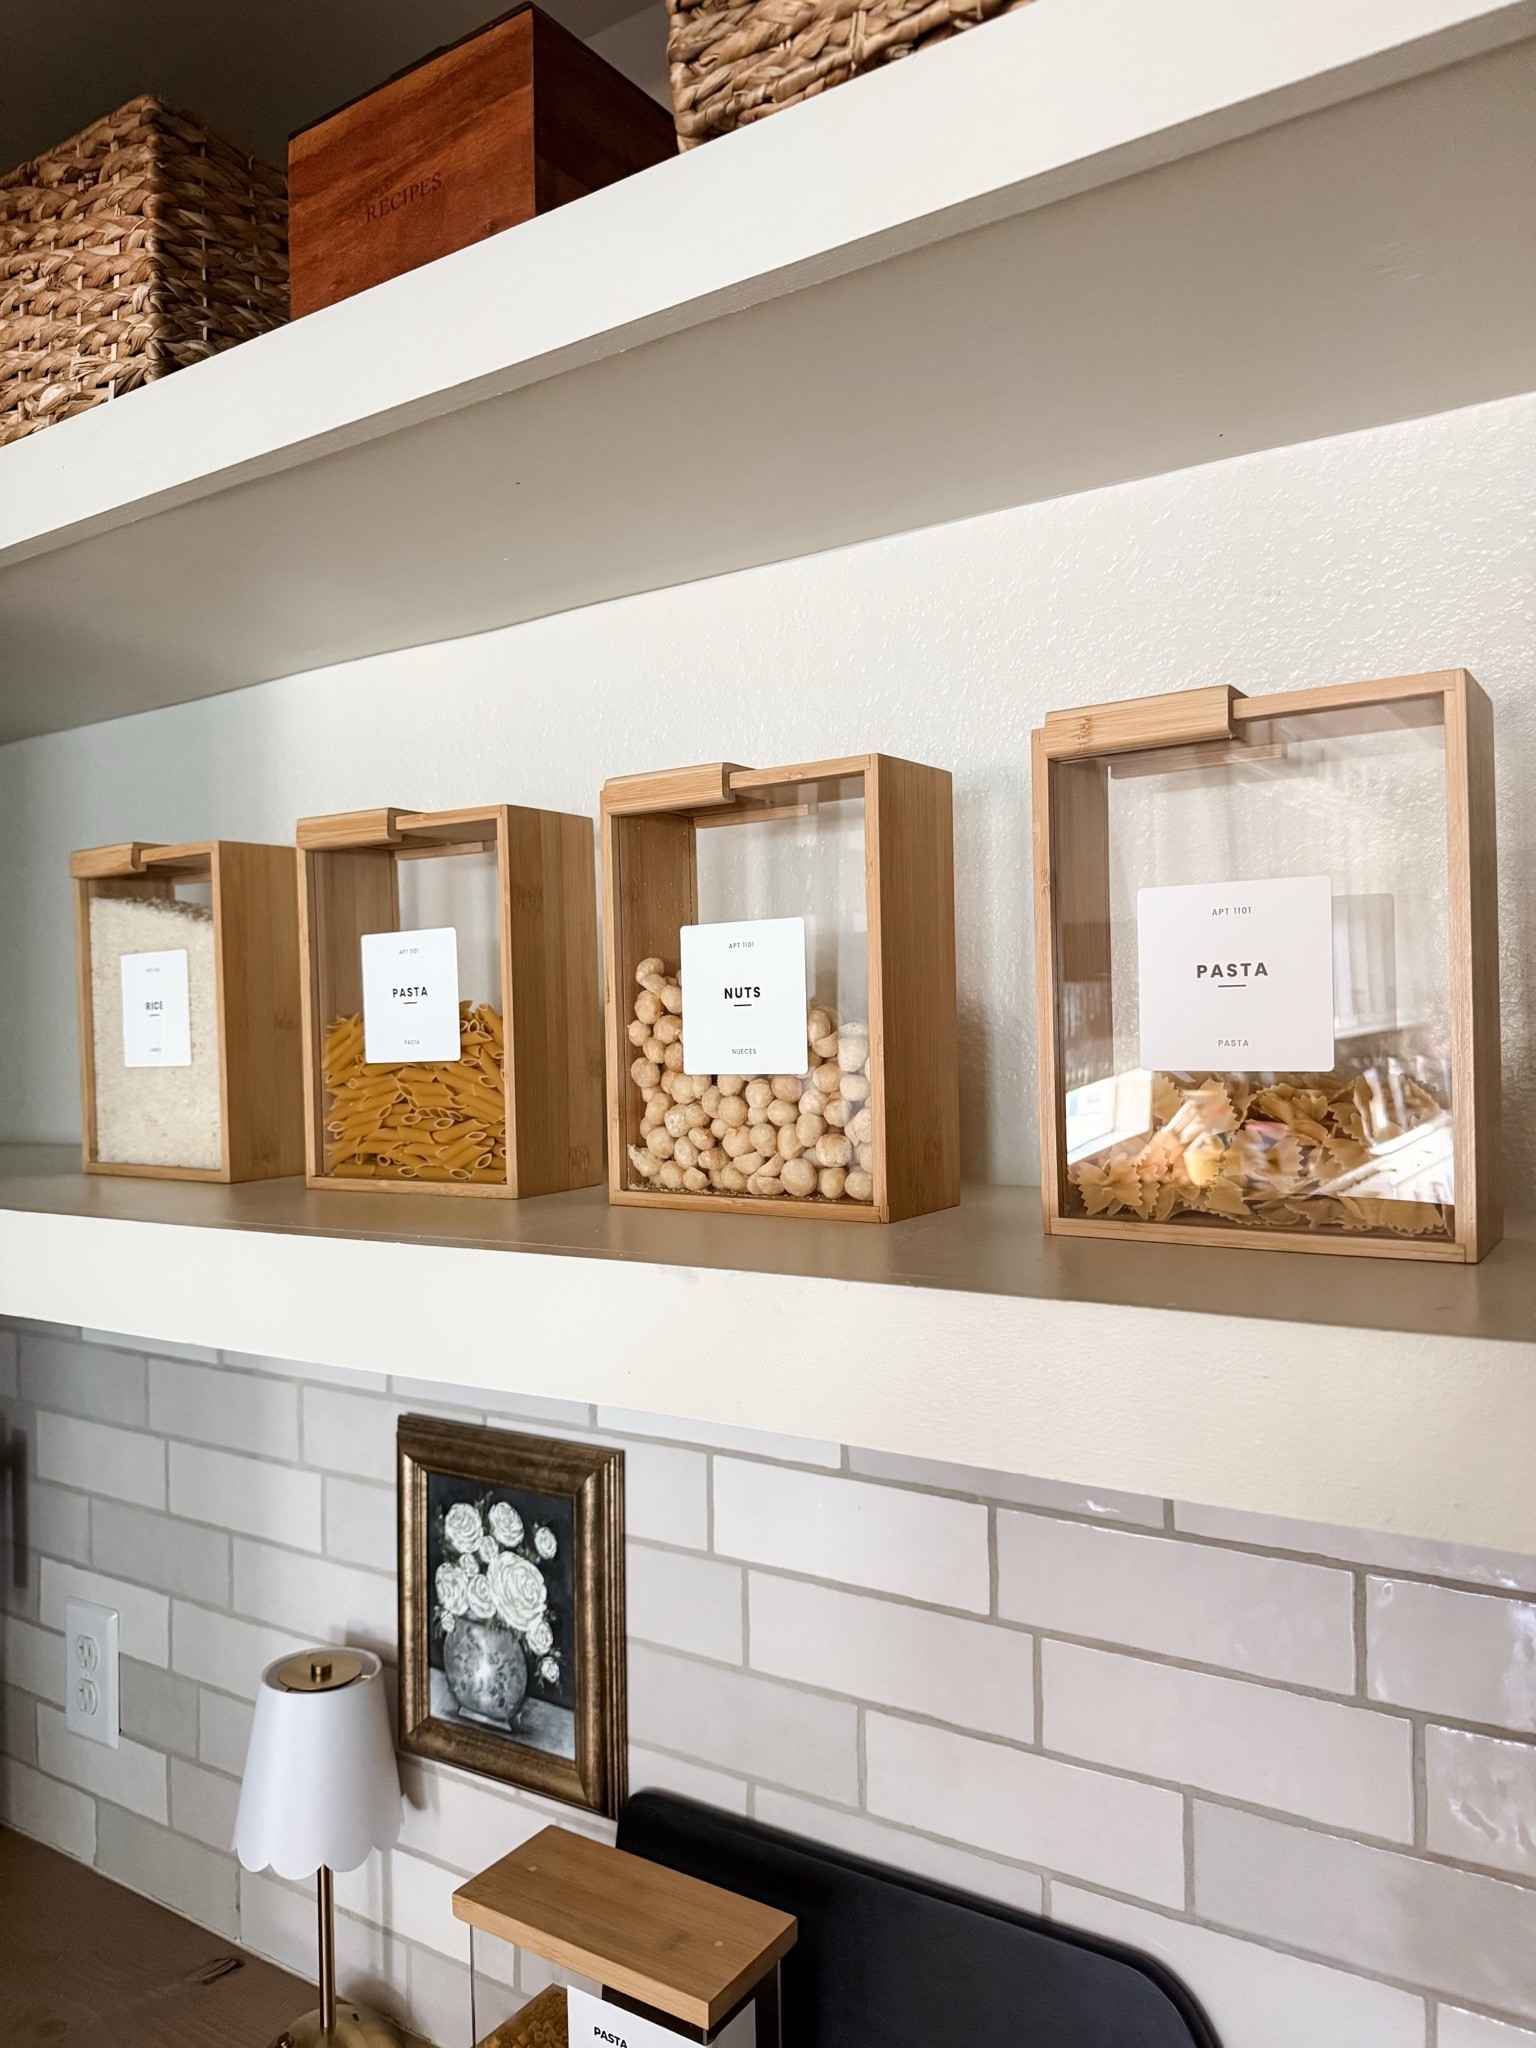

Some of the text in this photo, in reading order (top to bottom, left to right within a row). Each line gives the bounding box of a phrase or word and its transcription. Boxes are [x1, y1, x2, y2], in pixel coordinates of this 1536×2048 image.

[366, 172, 442, 224] RECIPES
[1211, 906, 1252, 916] APT 1101
[1196, 962, 1269, 979] PASTA
[392, 986, 428, 998] PASTA
[723, 986, 761, 1000] NUTS
[145, 1001, 164, 1011] RICE
[1217, 1039, 1249, 1047] PASTA
[593, 2026, 629, 2048] PASTA
